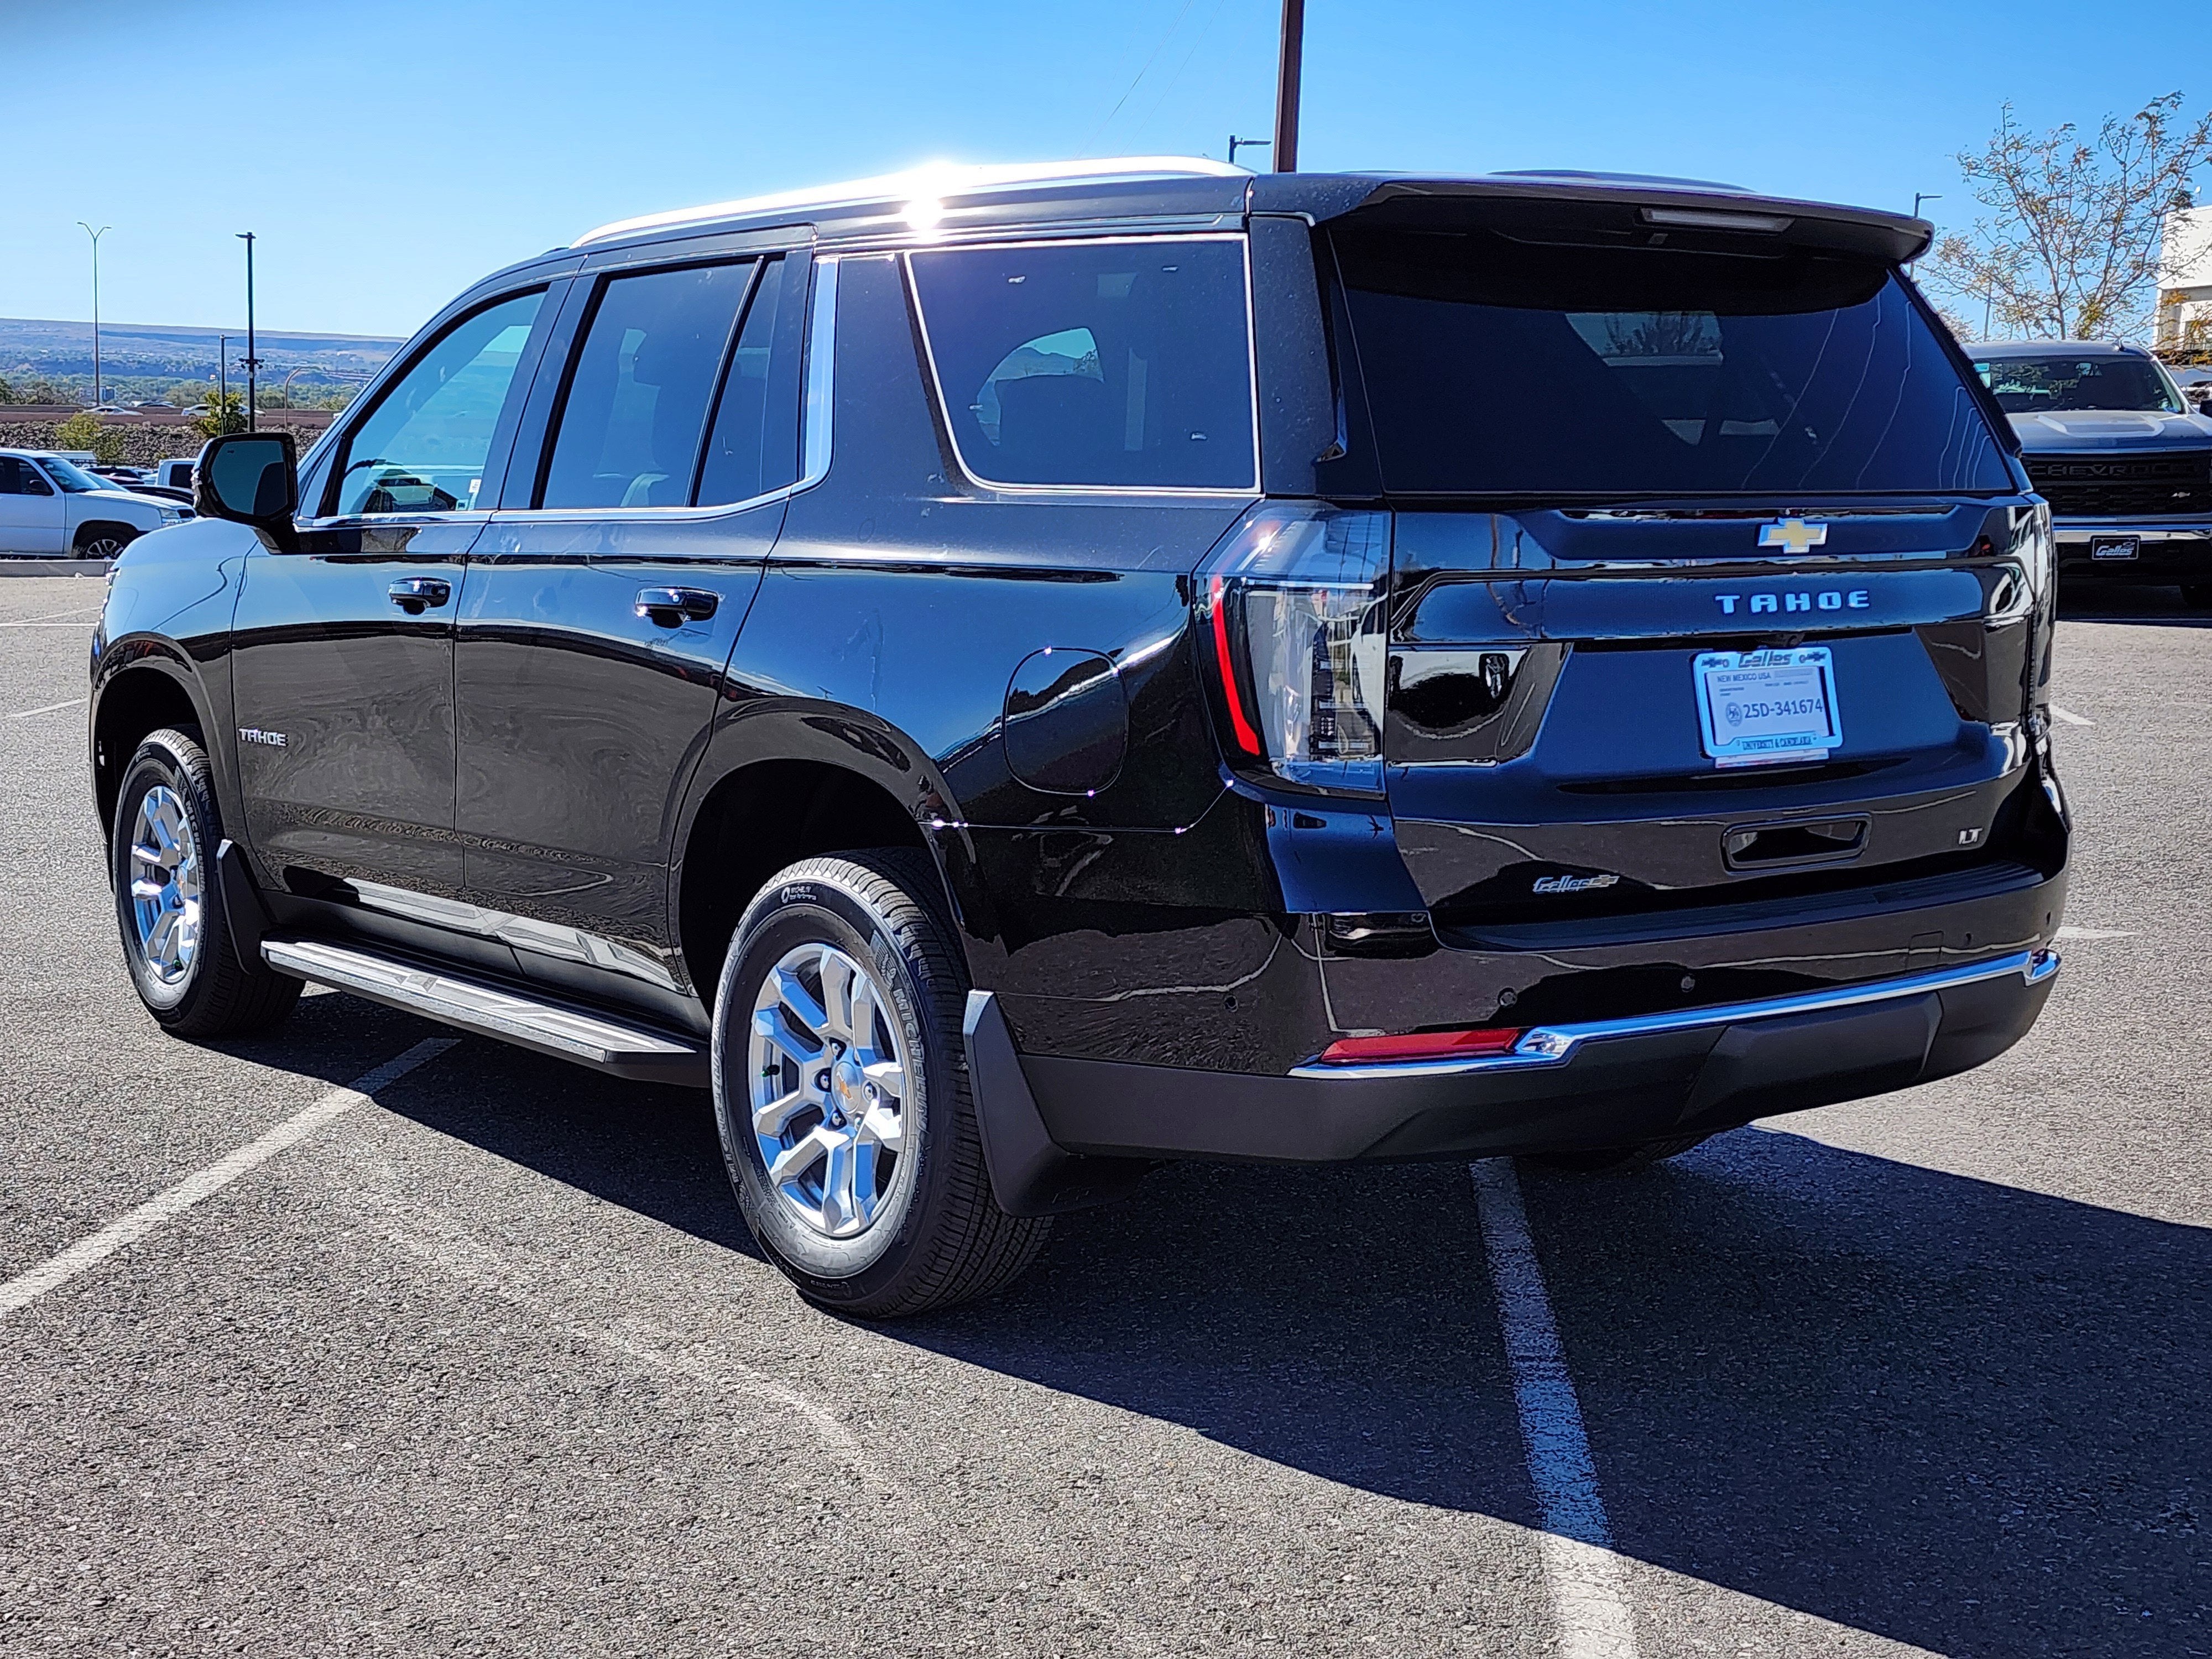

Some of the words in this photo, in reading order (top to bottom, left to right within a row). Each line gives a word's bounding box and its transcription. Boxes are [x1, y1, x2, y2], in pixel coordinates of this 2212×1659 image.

[2027, 463, 2199, 477] CHEVRO
[2095, 545, 2134, 556] Galles
[1715, 590, 1870, 614] TAHOE
[1743, 698, 1823, 718] 25D-341674
[238, 728, 287, 747] TAHOE
[1959, 828, 1983, 844] LT
[893, 987, 930, 1134] MICHELIN
